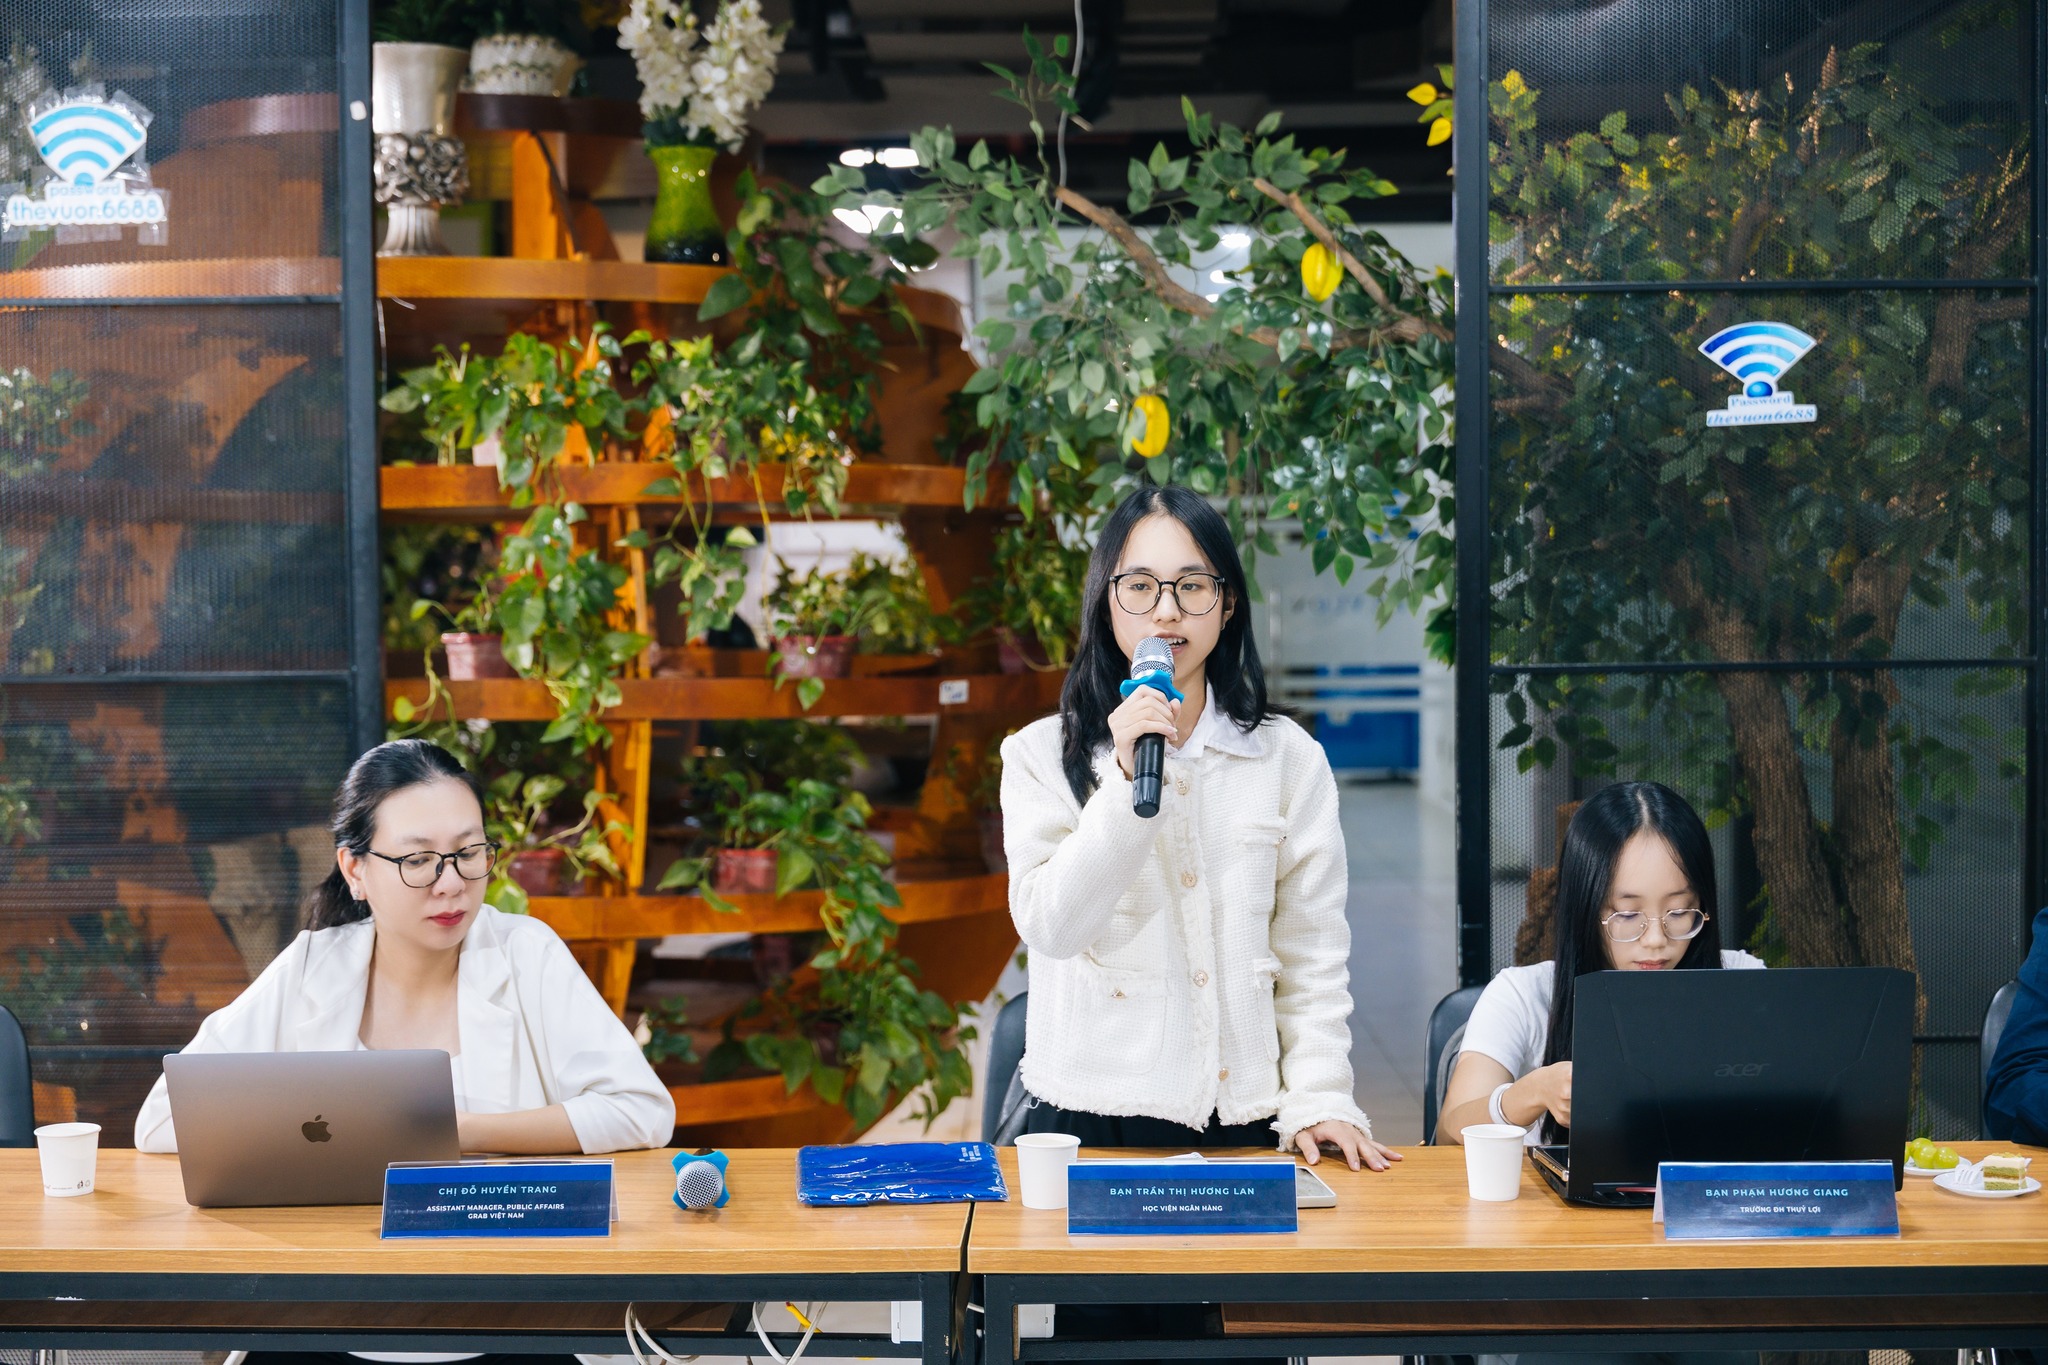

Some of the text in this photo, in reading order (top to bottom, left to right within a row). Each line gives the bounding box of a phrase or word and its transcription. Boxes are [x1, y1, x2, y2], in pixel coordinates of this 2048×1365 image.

[1731, 394, 1791, 407] Password
[1707, 408, 1814, 425] thevuon6688
[1714, 1063, 1770, 1077] acer
[438, 1187, 457, 1197] CHỊ
[461, 1184, 477, 1195] ĐỖ
[520, 1185, 557, 1194] TRANG
[1109, 1187, 1132, 1197] BẠN
[1168, 1187, 1187, 1197] THỊ
[1190, 1186, 1230, 1196] HƯƠNG
[1233, 1187, 1255, 1195] LAN
[1705, 1187, 1849, 1199] BẠN PHẠM HƯƠNG GIANG
[426, 1204, 466, 1212] ASSISTANT
[466, 1203, 505, 1211] MANAGER,
[506, 1203, 533, 1211] PUBLIC
[1142, 1205, 1159, 1213] HỌC
[1159, 1204, 1178, 1213] VIỆN
[1201, 1204, 1223, 1212] HÀNG
[1807, 1205, 1821, 1214] LỢI
[467, 1212, 488, 1220] GRAB
[489, 1211, 506, 1220] VIỆT
